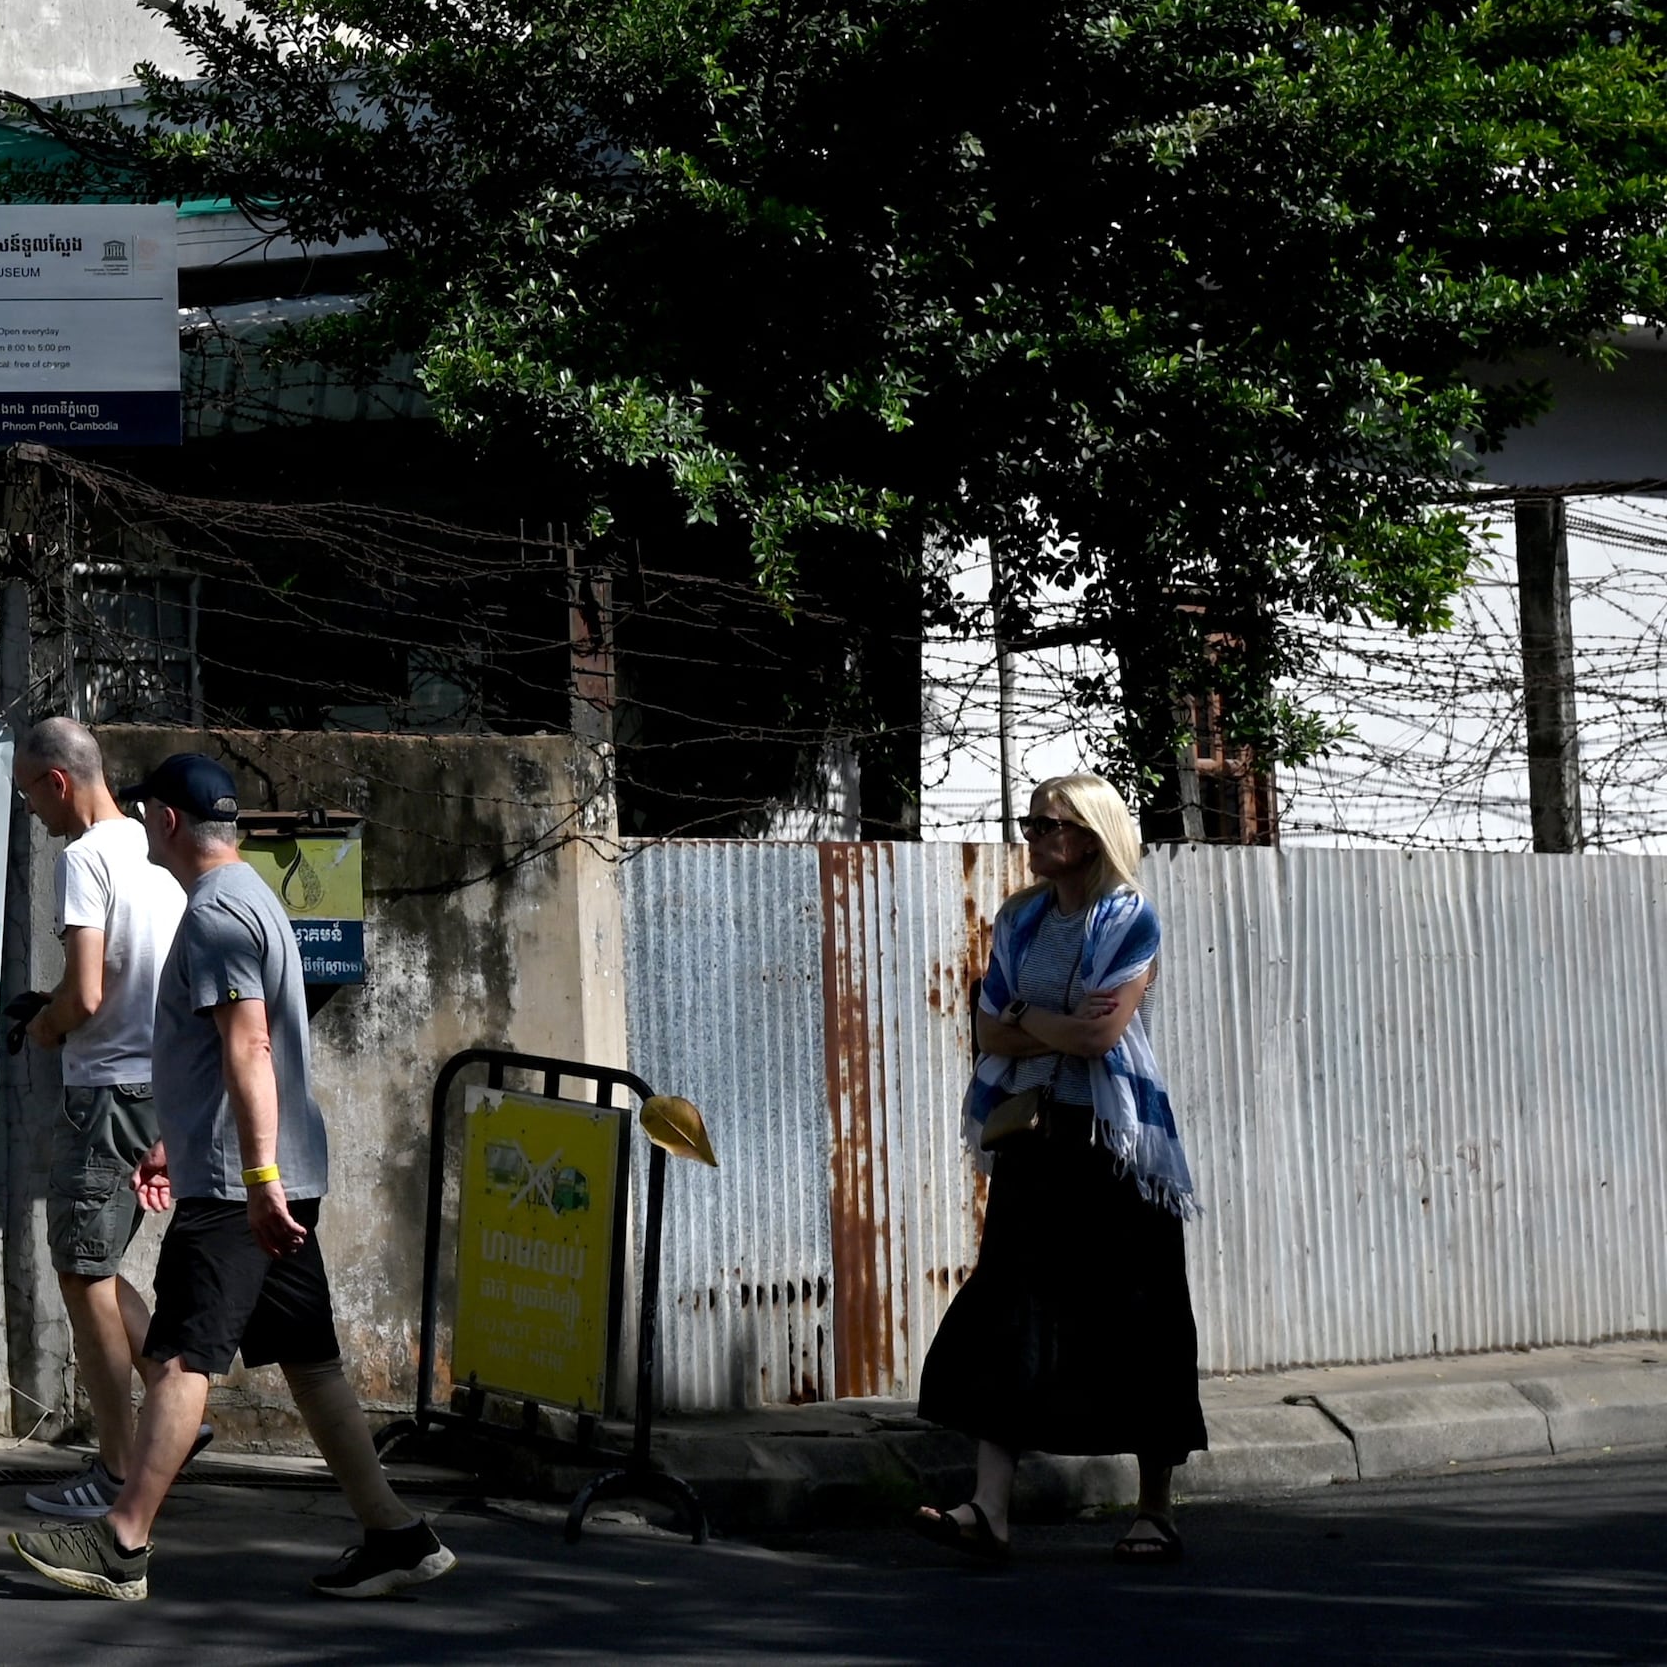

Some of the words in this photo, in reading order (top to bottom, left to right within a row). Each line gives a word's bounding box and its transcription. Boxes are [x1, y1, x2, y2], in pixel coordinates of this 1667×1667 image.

[22, 328, 60, 338] everyday
[7, 344, 25, 352] 8:00
[27, 344, 36, 352] to
[37, 344, 56, 352] 5:00
[58, 345, 71, 353] pm
[14, 360, 30, 369] free
[31, 360, 41, 369] of
[42, 360, 71, 370] charge
[2, 421, 37, 431] Phnom
[38, 421, 67, 432] Penh,
[69, 421, 119, 431] Cambodia
[500, 1319, 531, 1341] NOT
